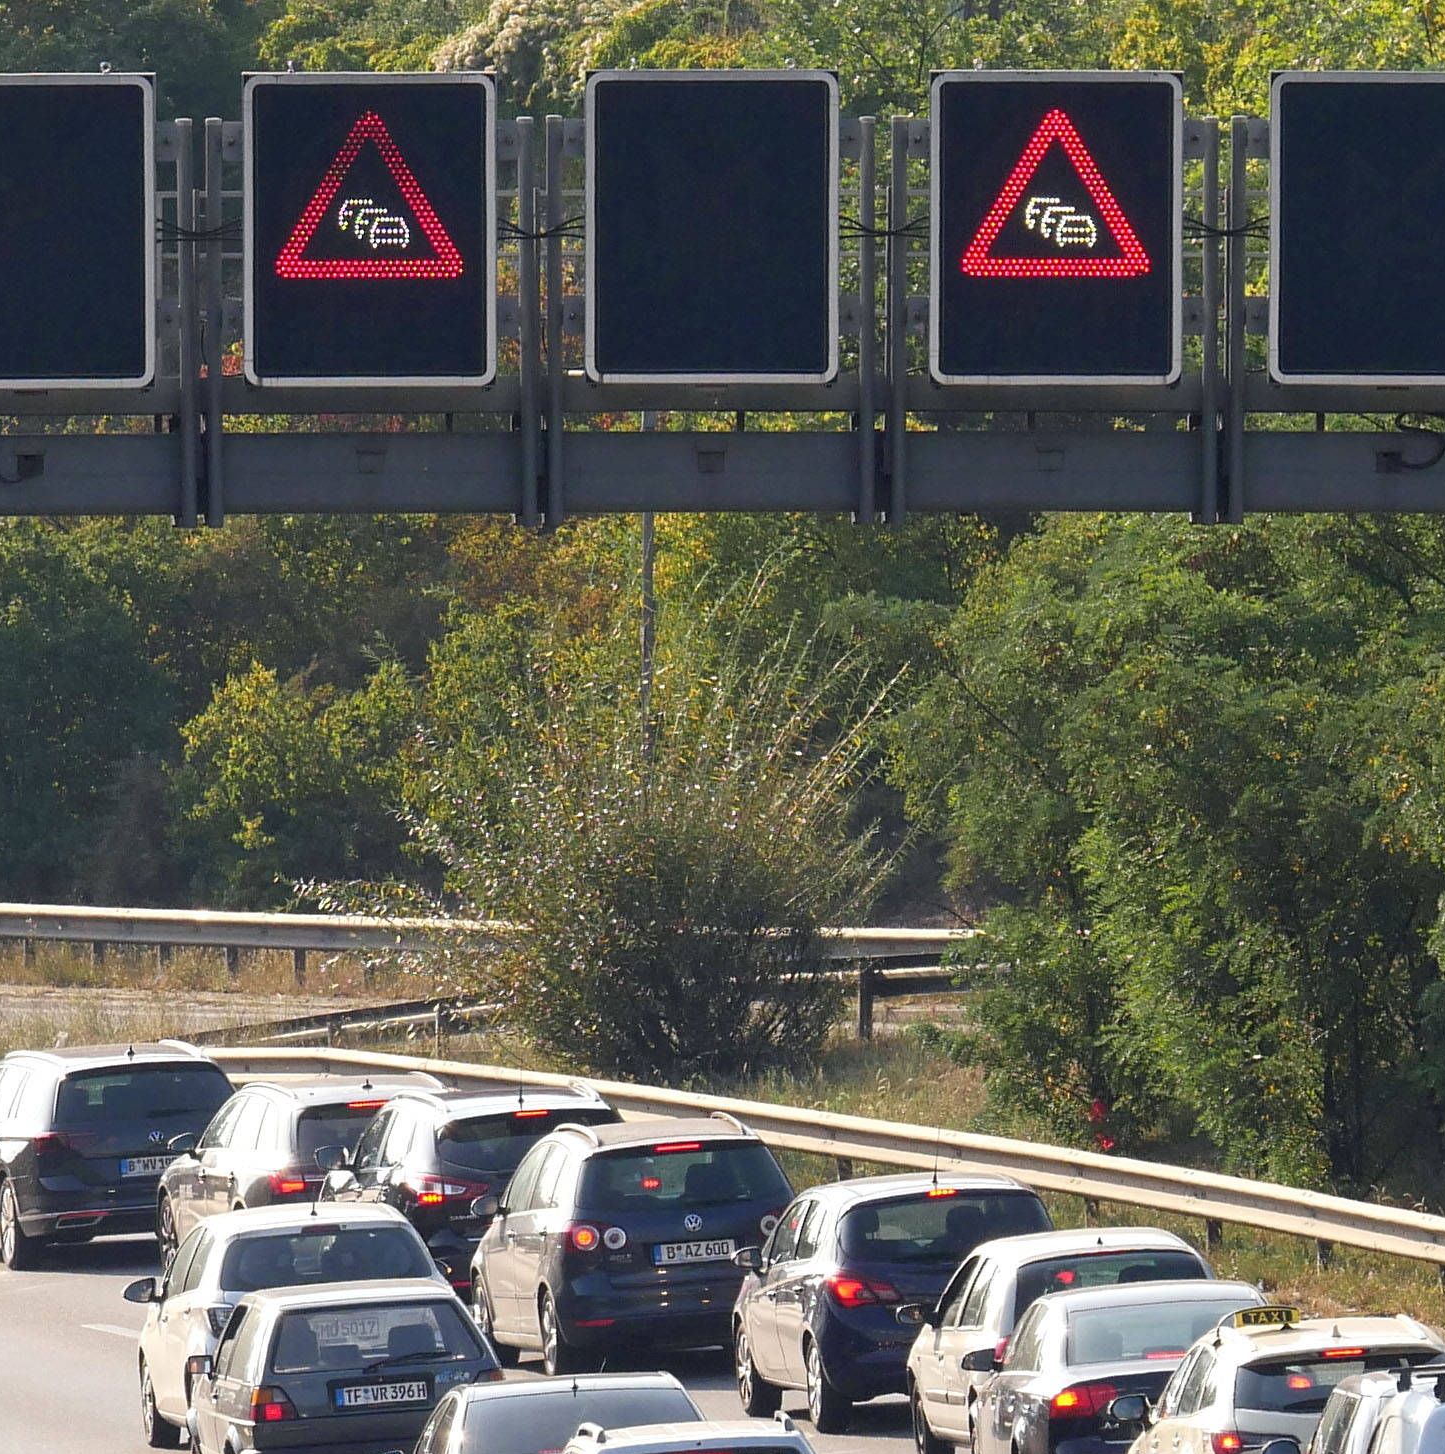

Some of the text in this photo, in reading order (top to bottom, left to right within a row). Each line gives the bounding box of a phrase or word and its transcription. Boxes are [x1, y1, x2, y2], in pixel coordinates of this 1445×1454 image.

[666, 1242, 730, 1259] B AZ 600
[1248, 1311, 1288, 1324] TAXI
[345, 1389, 362, 1403] TF
[371, 1386, 388, 1400] VR
